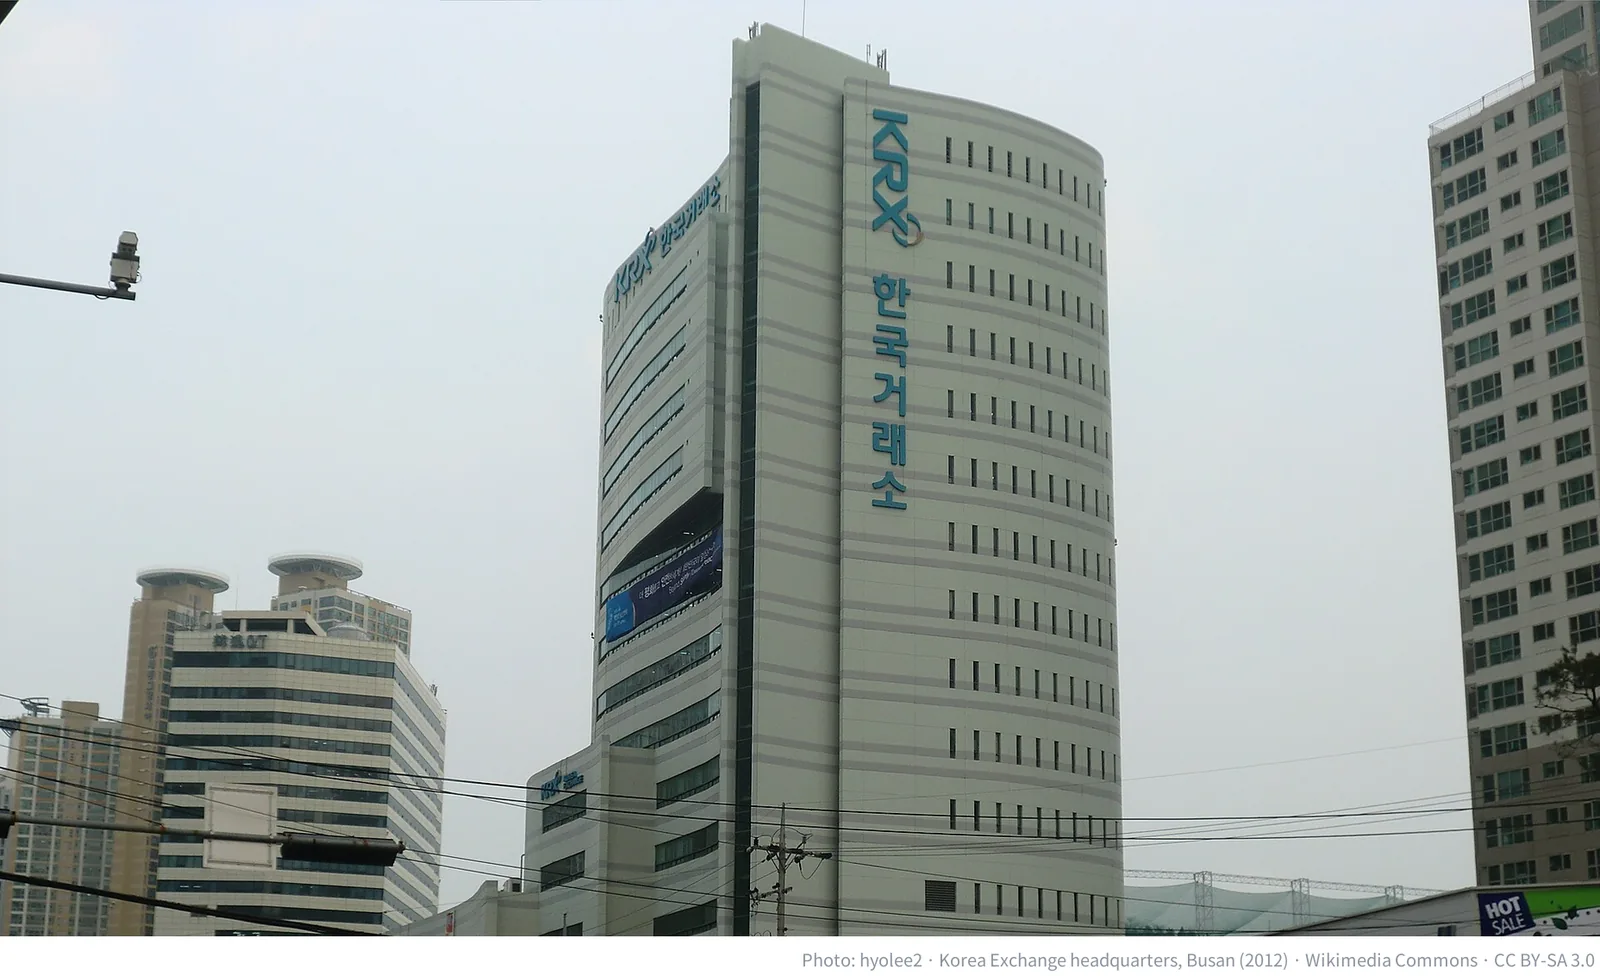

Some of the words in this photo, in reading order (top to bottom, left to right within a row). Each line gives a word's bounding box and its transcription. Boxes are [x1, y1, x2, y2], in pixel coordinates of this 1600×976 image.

[872, 108, 924, 248] KRX
[614, 227, 657, 303] KRX
[872, 273, 911, 510] 한국거래소
[1485, 896, 1520, 920] HOT
[1492, 913, 1526, 936] SALE
